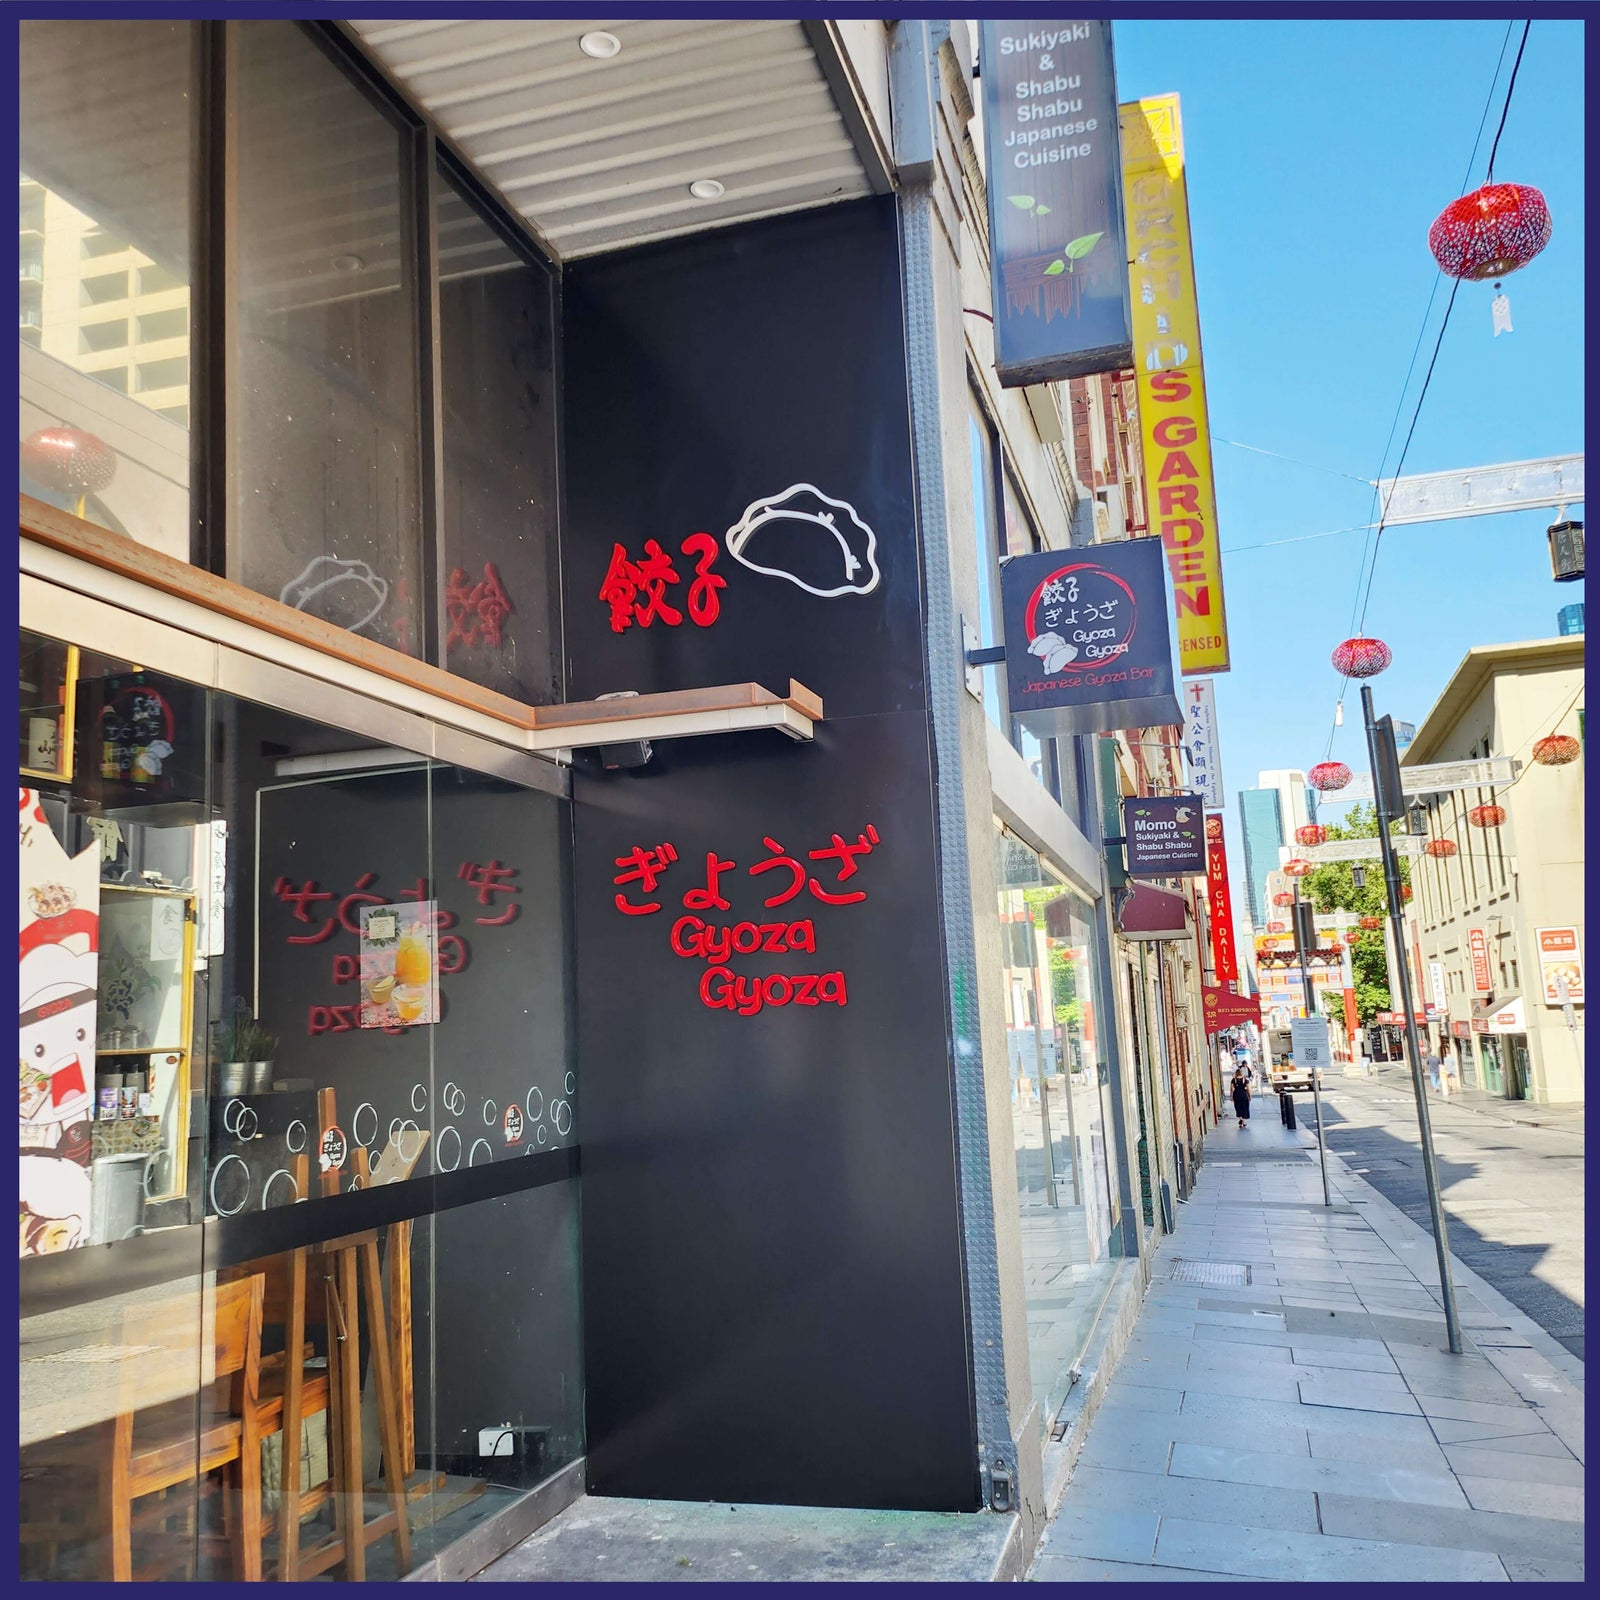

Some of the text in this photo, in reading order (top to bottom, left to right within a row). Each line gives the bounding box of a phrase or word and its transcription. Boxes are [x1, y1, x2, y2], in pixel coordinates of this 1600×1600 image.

[1000, 22, 1090, 55] Sukiyaki
[1039, 54, 1055, 70] &
[1015, 73, 1081, 98] Shabu
[1017, 96, 1083, 122] Shabu
[1004, 118, 1098, 147] Japanese
[1014, 142, 1091, 168] Cuisine
[1153, 416, 1211, 619] GARDEN
[600, 532, 727, 633] 餃子
[1040, 577, 1079, 606] 餃子
[1073, 628, 1116, 644] Gyoza
[1180, 636, 1222, 652] ENSED
[1085, 643, 1129, 658] Gyoza
[1022, 667, 1154, 693] Japanese Gyoza Bar
[1135, 820, 1176, 831] Momo
[1136, 832, 1171, 841] Sukiyaki
[1137, 853, 1170, 861] Japanese
[1212, 854, 1222, 880] YUM
[1215, 890, 1225, 917] CHA
[671, 915, 816, 964] Gyoza
[1219, 928, 1230, 973] DAILY
[699, 966, 847, 1016] Gyoza
